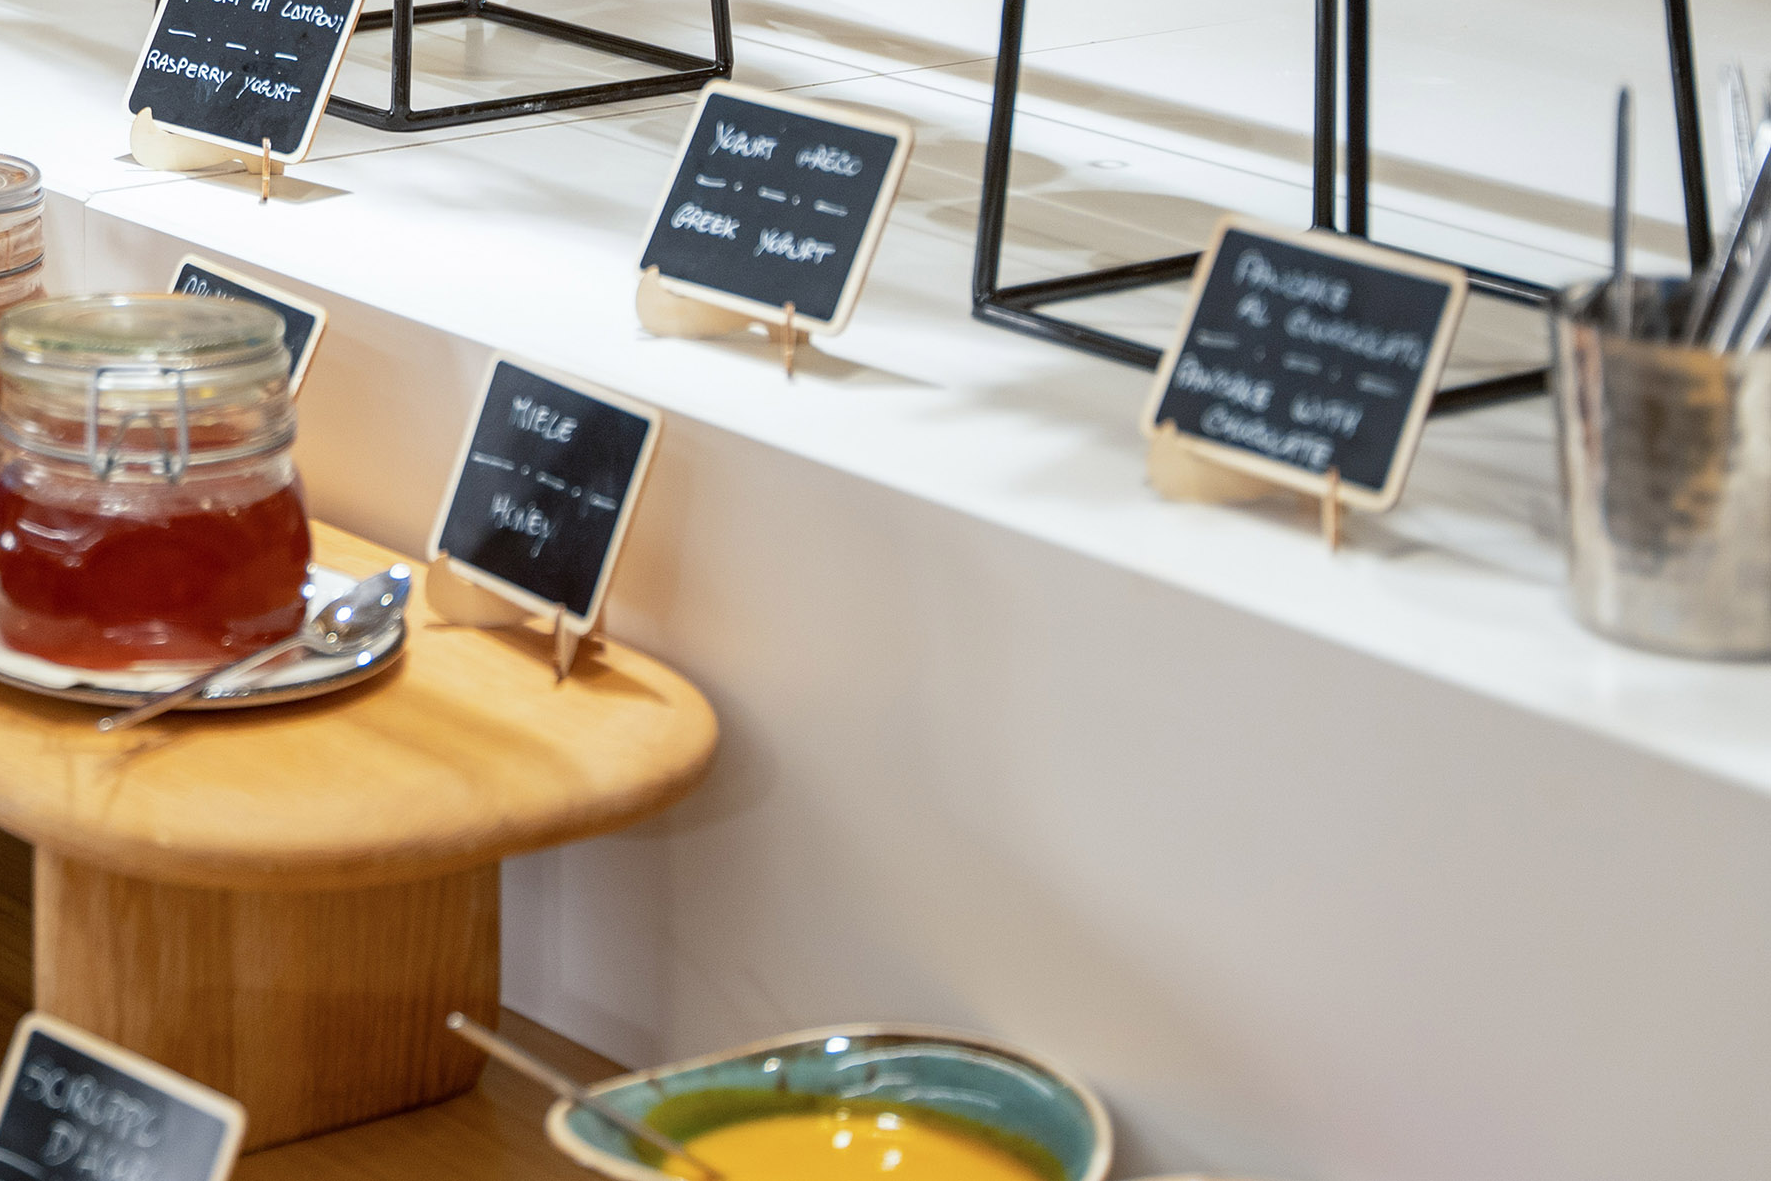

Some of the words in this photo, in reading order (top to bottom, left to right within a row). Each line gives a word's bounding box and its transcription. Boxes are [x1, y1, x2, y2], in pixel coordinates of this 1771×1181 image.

[145, 49, 233, 93] RASPERRY
[236, 77, 301, 101] YOGURT
[711, 122, 777, 160] YOGURT
[671, 202, 740, 240] GREEK
[755, 229, 836, 264] YOGURT
[510, 395, 578, 443] MIELE
